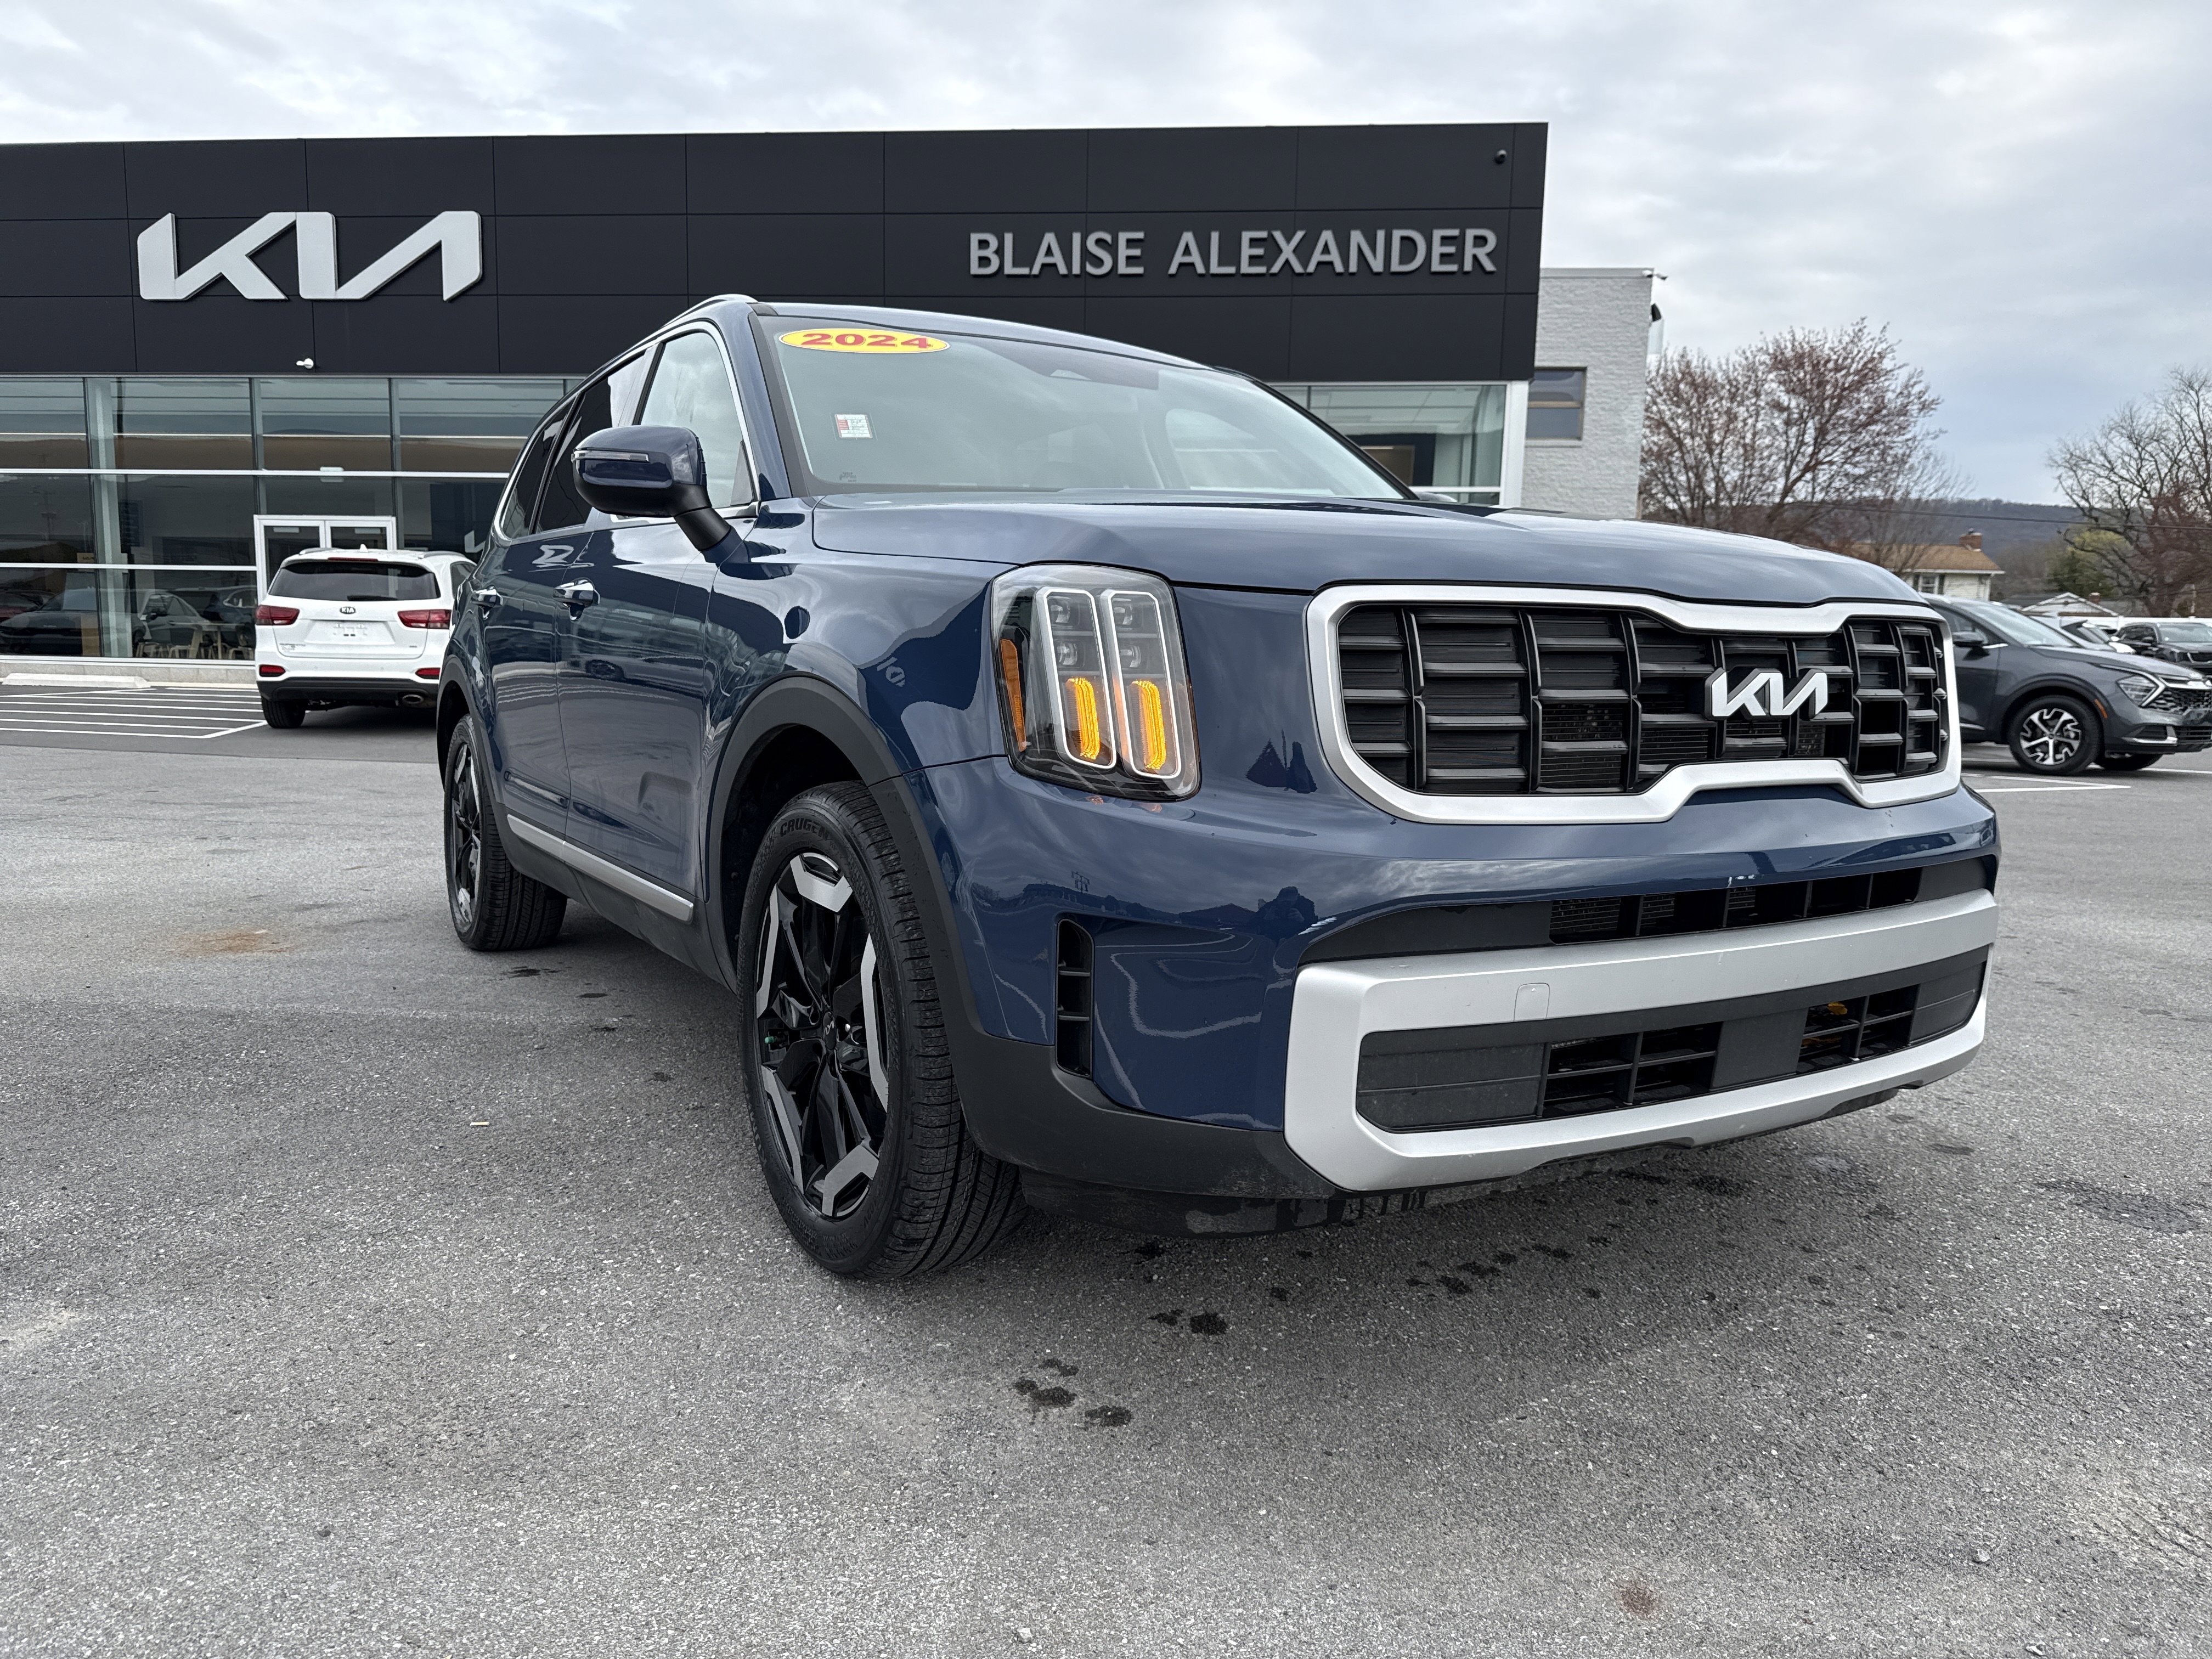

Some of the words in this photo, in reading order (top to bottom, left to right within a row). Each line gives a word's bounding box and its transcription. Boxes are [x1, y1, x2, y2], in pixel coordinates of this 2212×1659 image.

[137, 211, 482, 301] KIA
[970, 231, 1145, 276] BLAISE
[1167, 228, 1497, 275] ALEXANDER
[800, 332, 934, 349] 2024
[1710, 670, 1828, 717] KIA
[780, 817, 830, 841] CRUGEN
